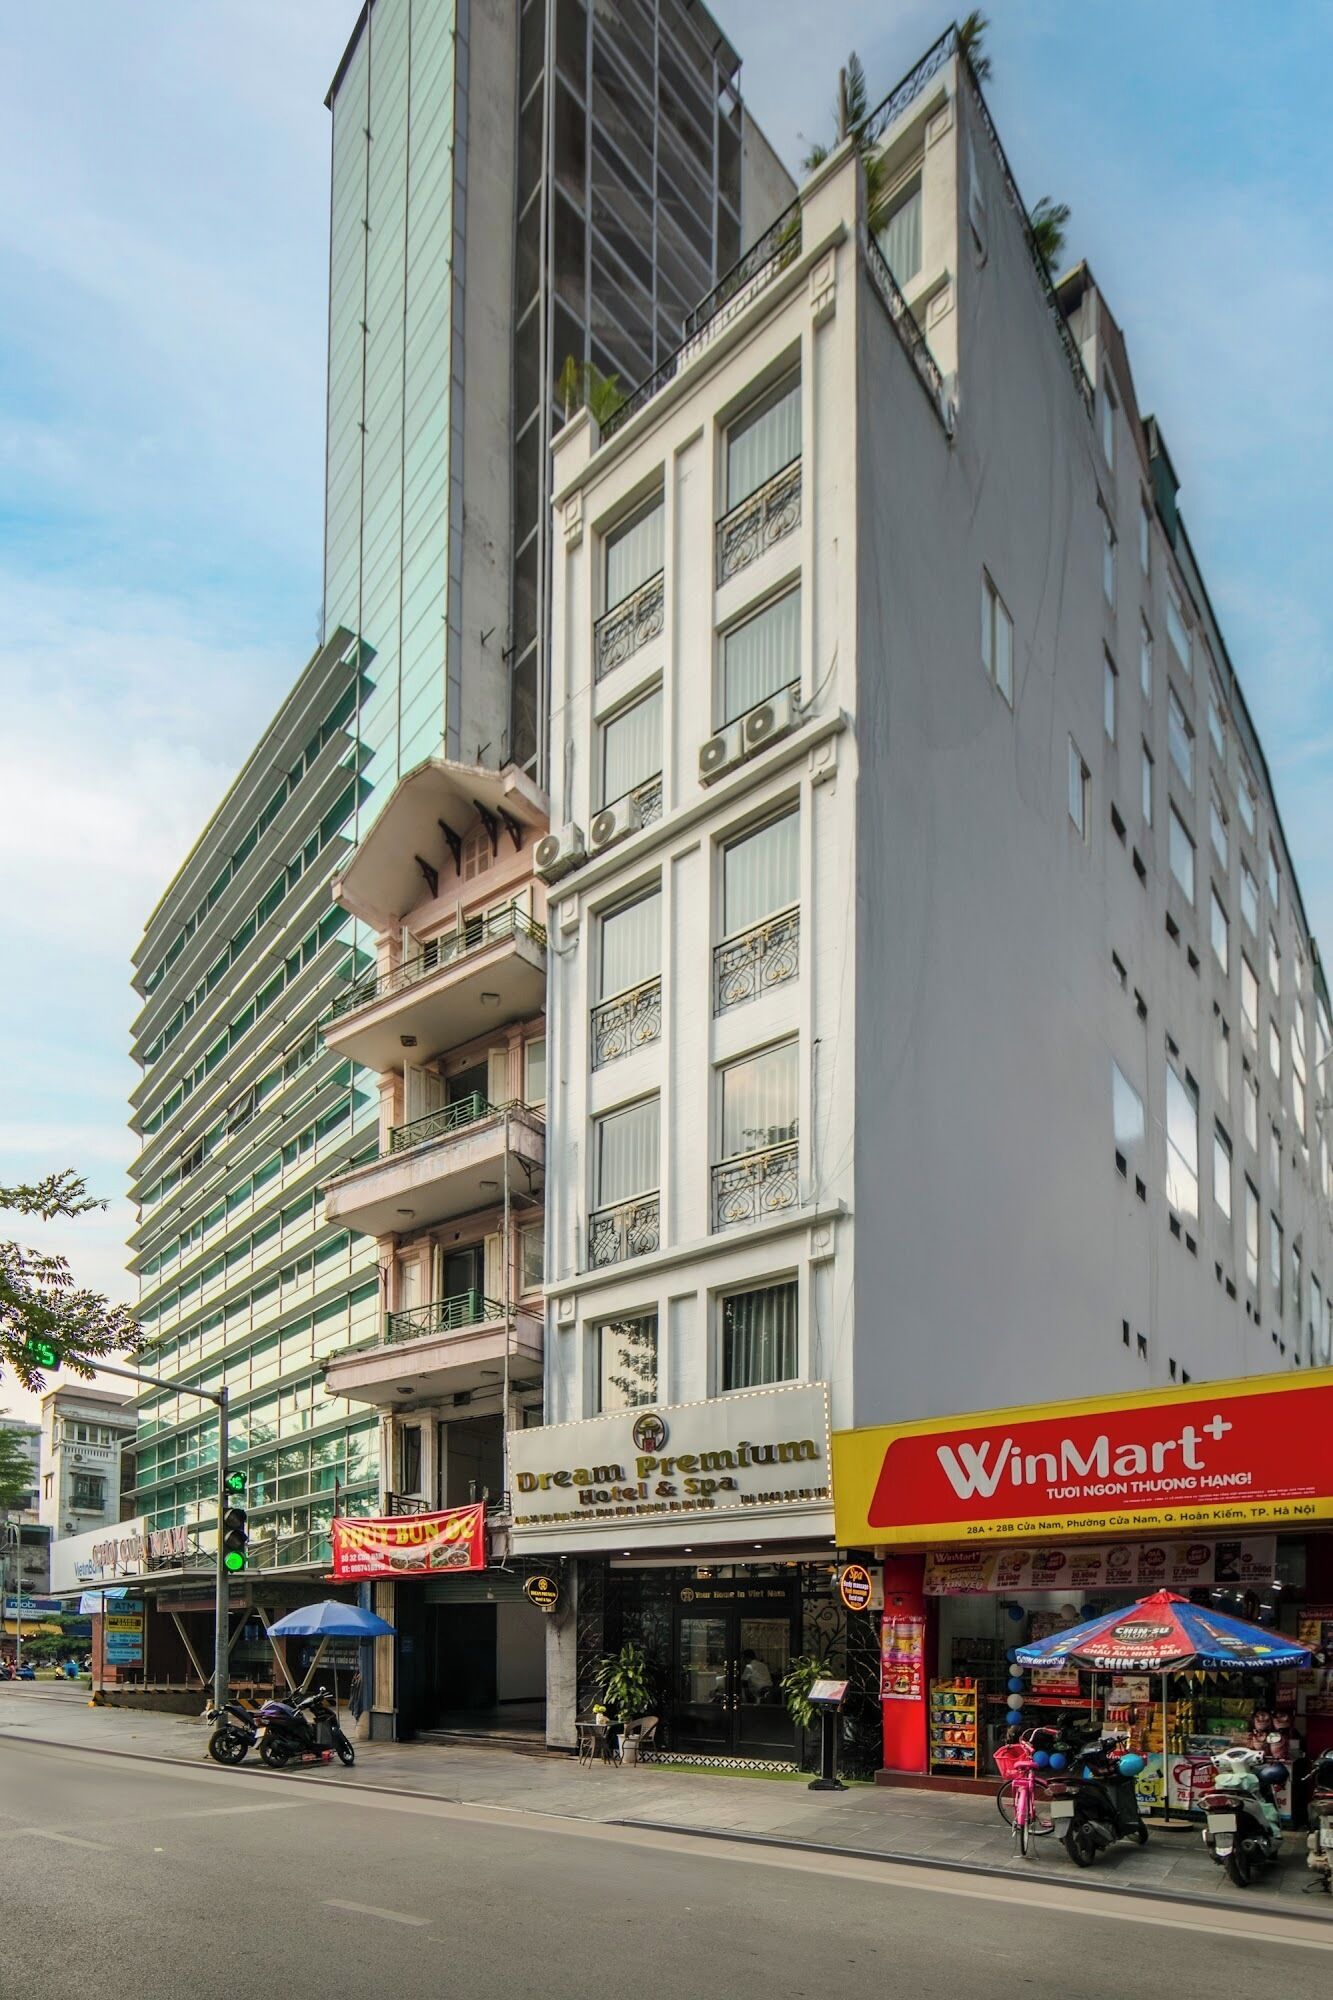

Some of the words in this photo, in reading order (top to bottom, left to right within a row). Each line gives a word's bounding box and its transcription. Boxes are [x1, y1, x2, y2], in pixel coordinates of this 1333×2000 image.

[516, 1463, 625, 1492] Dream
[635, 1440, 820, 1478] Premium
[578, 1482, 648, 1505] Hotel
[655, 1480, 677, 1498] &
[683, 1476, 738, 1497] Spa
[1084, 1482, 1127, 1497] NGON
[1131, 1476, 1197, 1493] THƯỢNG
[1201, 1472, 1252, 1489] HẠNG!
[967, 1526, 985, 1534] 28A
[996, 1523, 1014, 1532] 28B
[1017, 1521, 1036, 1531] Cửa
[1039, 1521, 1064, 1530] Nam,
[1067, 1518, 1106, 1528] Phường
[1110, 1515, 1129, 1525] Cửa
[1133, 1514, 1161, 1524] Nam,
[1164, 1513, 1176, 1522] Q.
[1213, 1507, 1246, 1519] Kiếm,
[1251, 1508, 1269, 1517] TP.
[1273, 1505, 1289, 1515] Hà
[1294, 1504, 1315, 1516] Nội
[148, 1526, 188, 1557] NAM
[849, 1567, 863, 1582] Spa
[1115, 1626, 1170, 1635] CHIN-SU
[1095, 1656, 1161, 1671] CHIN-SU
